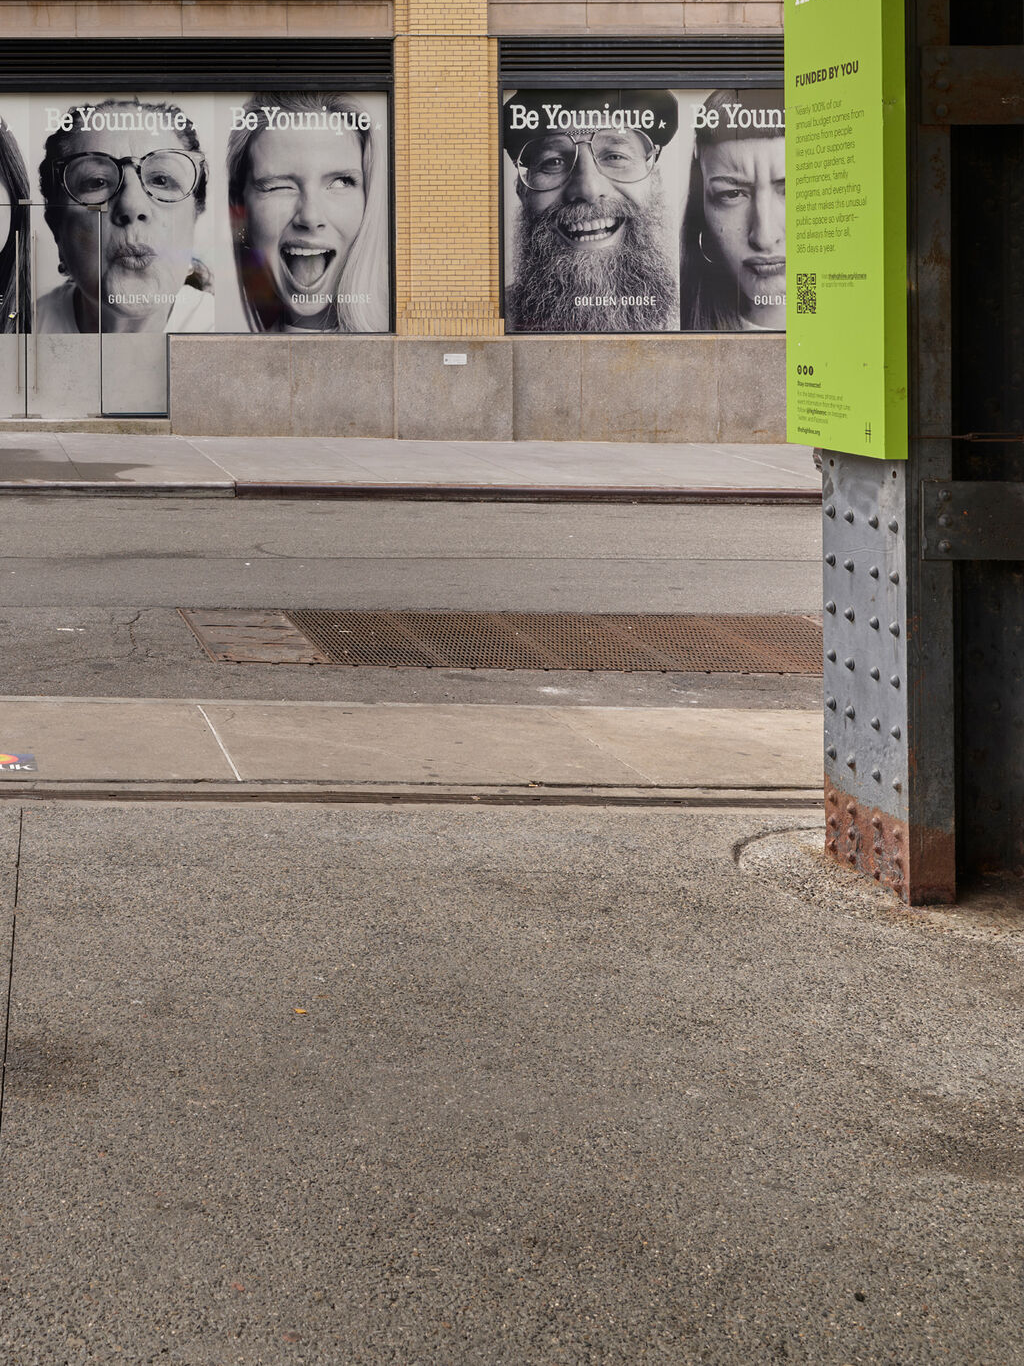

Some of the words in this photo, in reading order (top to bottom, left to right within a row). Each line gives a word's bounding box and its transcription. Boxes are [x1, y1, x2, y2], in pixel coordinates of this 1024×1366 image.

[795, 68, 827, 88] FUNDED
[828, 65, 840, 80] BY
[840, 60, 859, 77] YOU
[44, 107, 74, 132] Be
[76, 106, 187, 136] Younique
[230, 107, 259, 132] Be
[260, 106, 372, 136] Younique
[510, 104, 540, 130] Be
[541, 103, 655, 134] Younique
[690, 104, 719, 130] Be
[107, 293, 150, 305] GOLDEN
[291, 293, 333, 304] GOLDEN
[337, 293, 372, 304] GOOSE
[574, 296, 618, 307] GOLDEN
[621, 295, 657, 306] GOOSE
